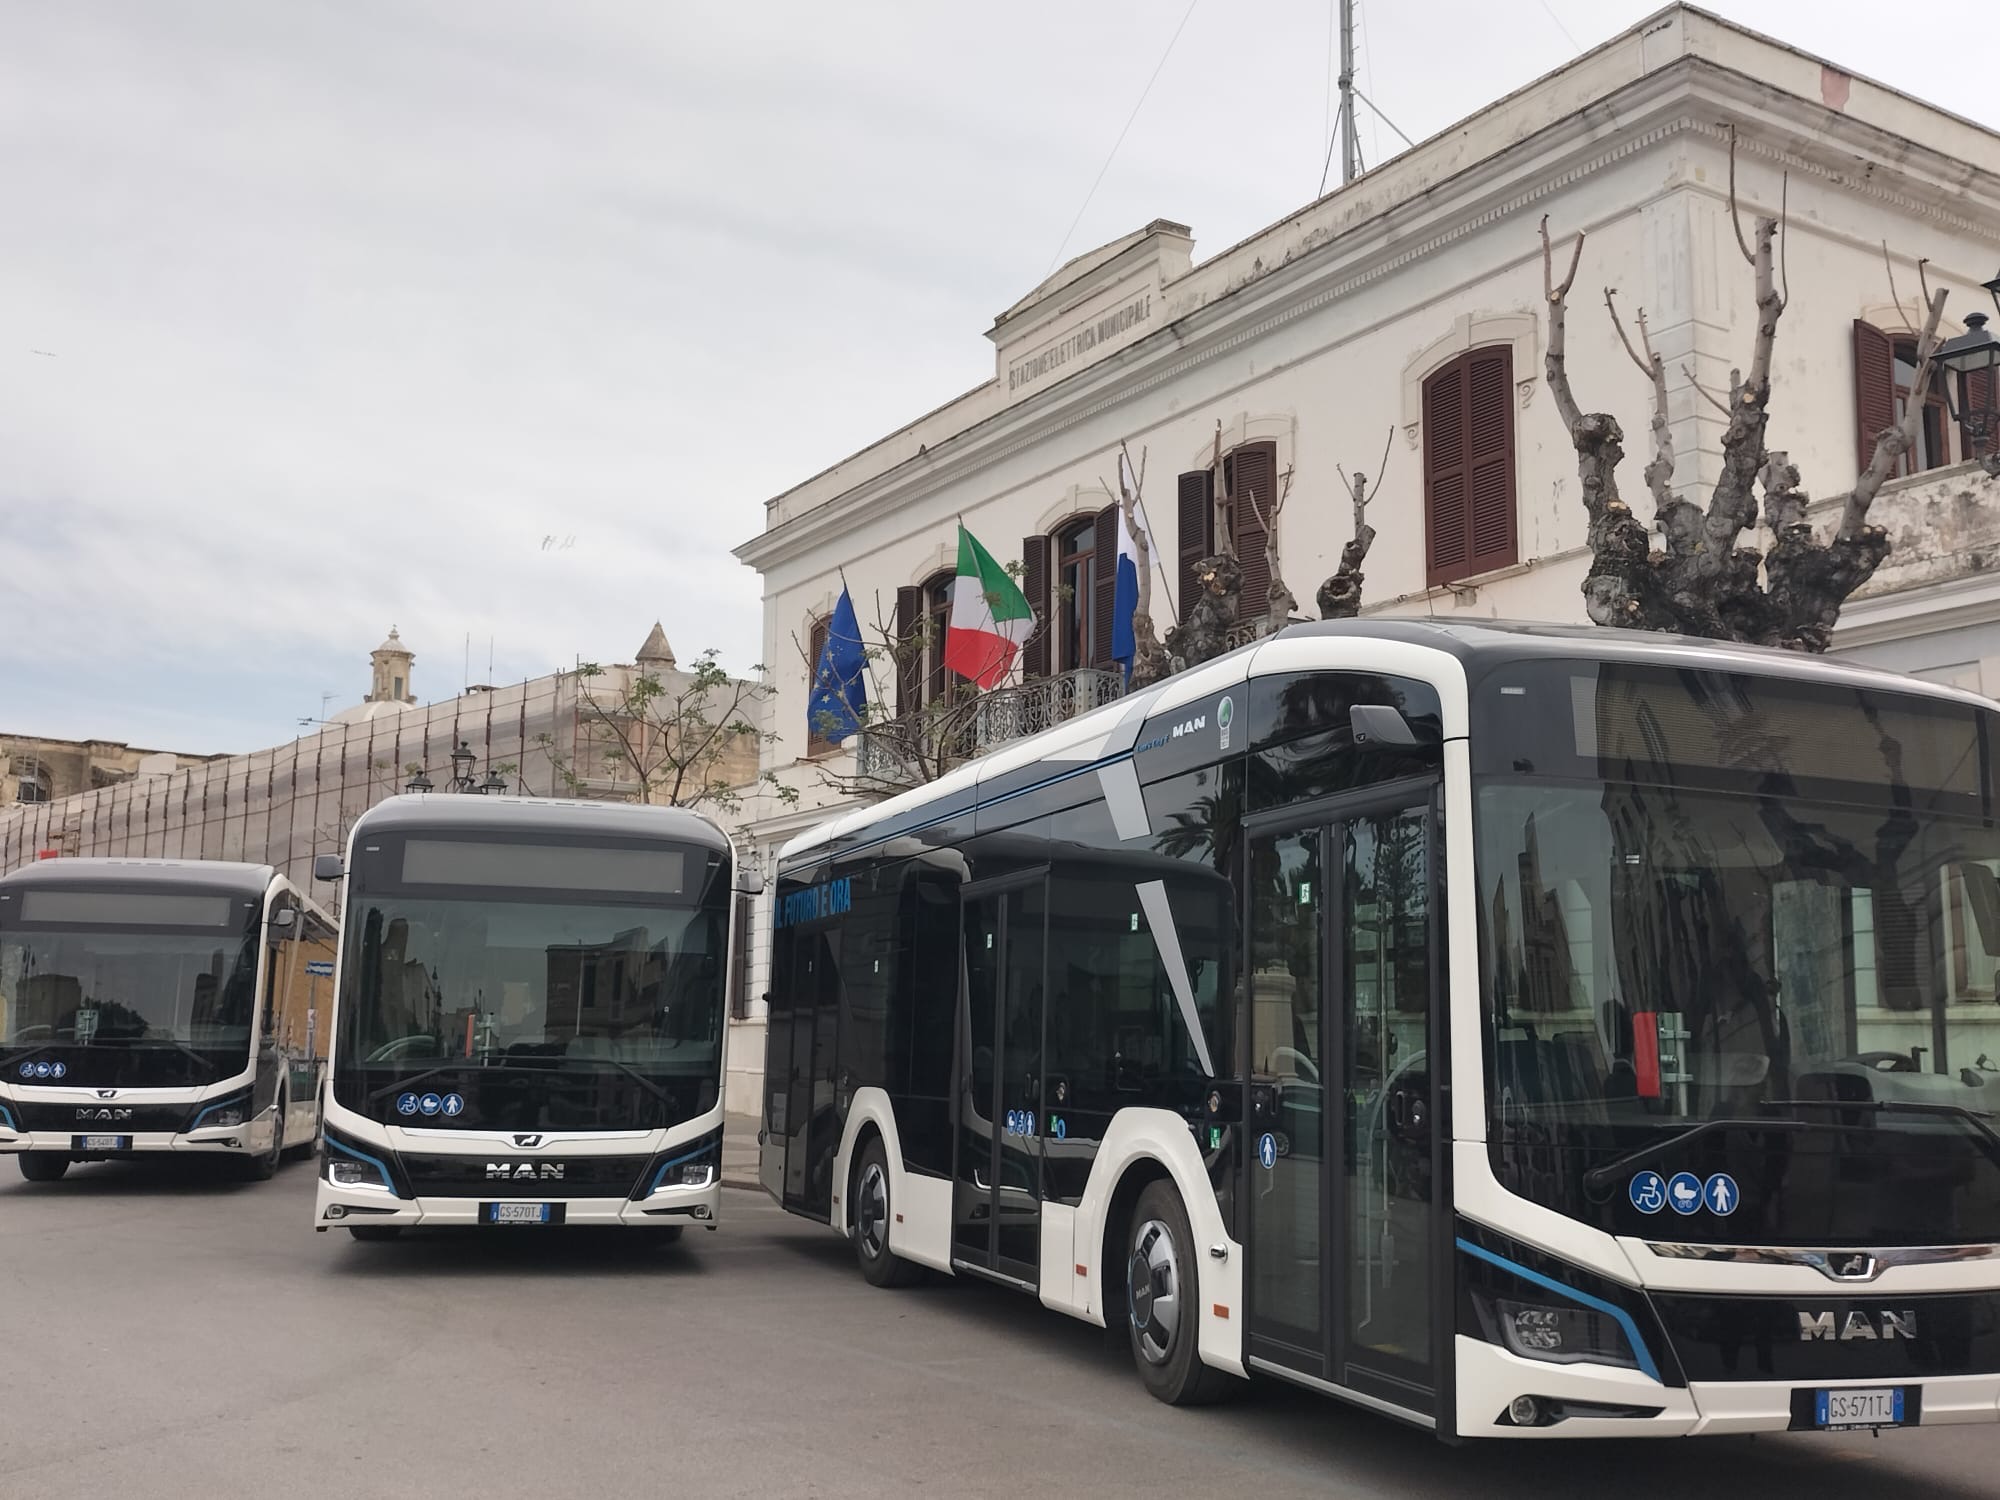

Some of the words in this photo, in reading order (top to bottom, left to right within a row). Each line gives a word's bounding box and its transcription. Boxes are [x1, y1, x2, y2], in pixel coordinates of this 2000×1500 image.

[1009, 351, 1049, 390] STAZIONE
[1051, 325, 1096, 370] ELETTRICA
[1098, 294, 1151, 345] MUNICIPALE
[1172, 715, 1206, 738] MAN
[785, 887, 818, 927] FUTURO
[830, 876, 851, 916] ORA
[76, 1108, 132, 1120] MAN
[486, 1163, 564, 1179] MAN
[1798, 1310, 1918, 1341] MAN
